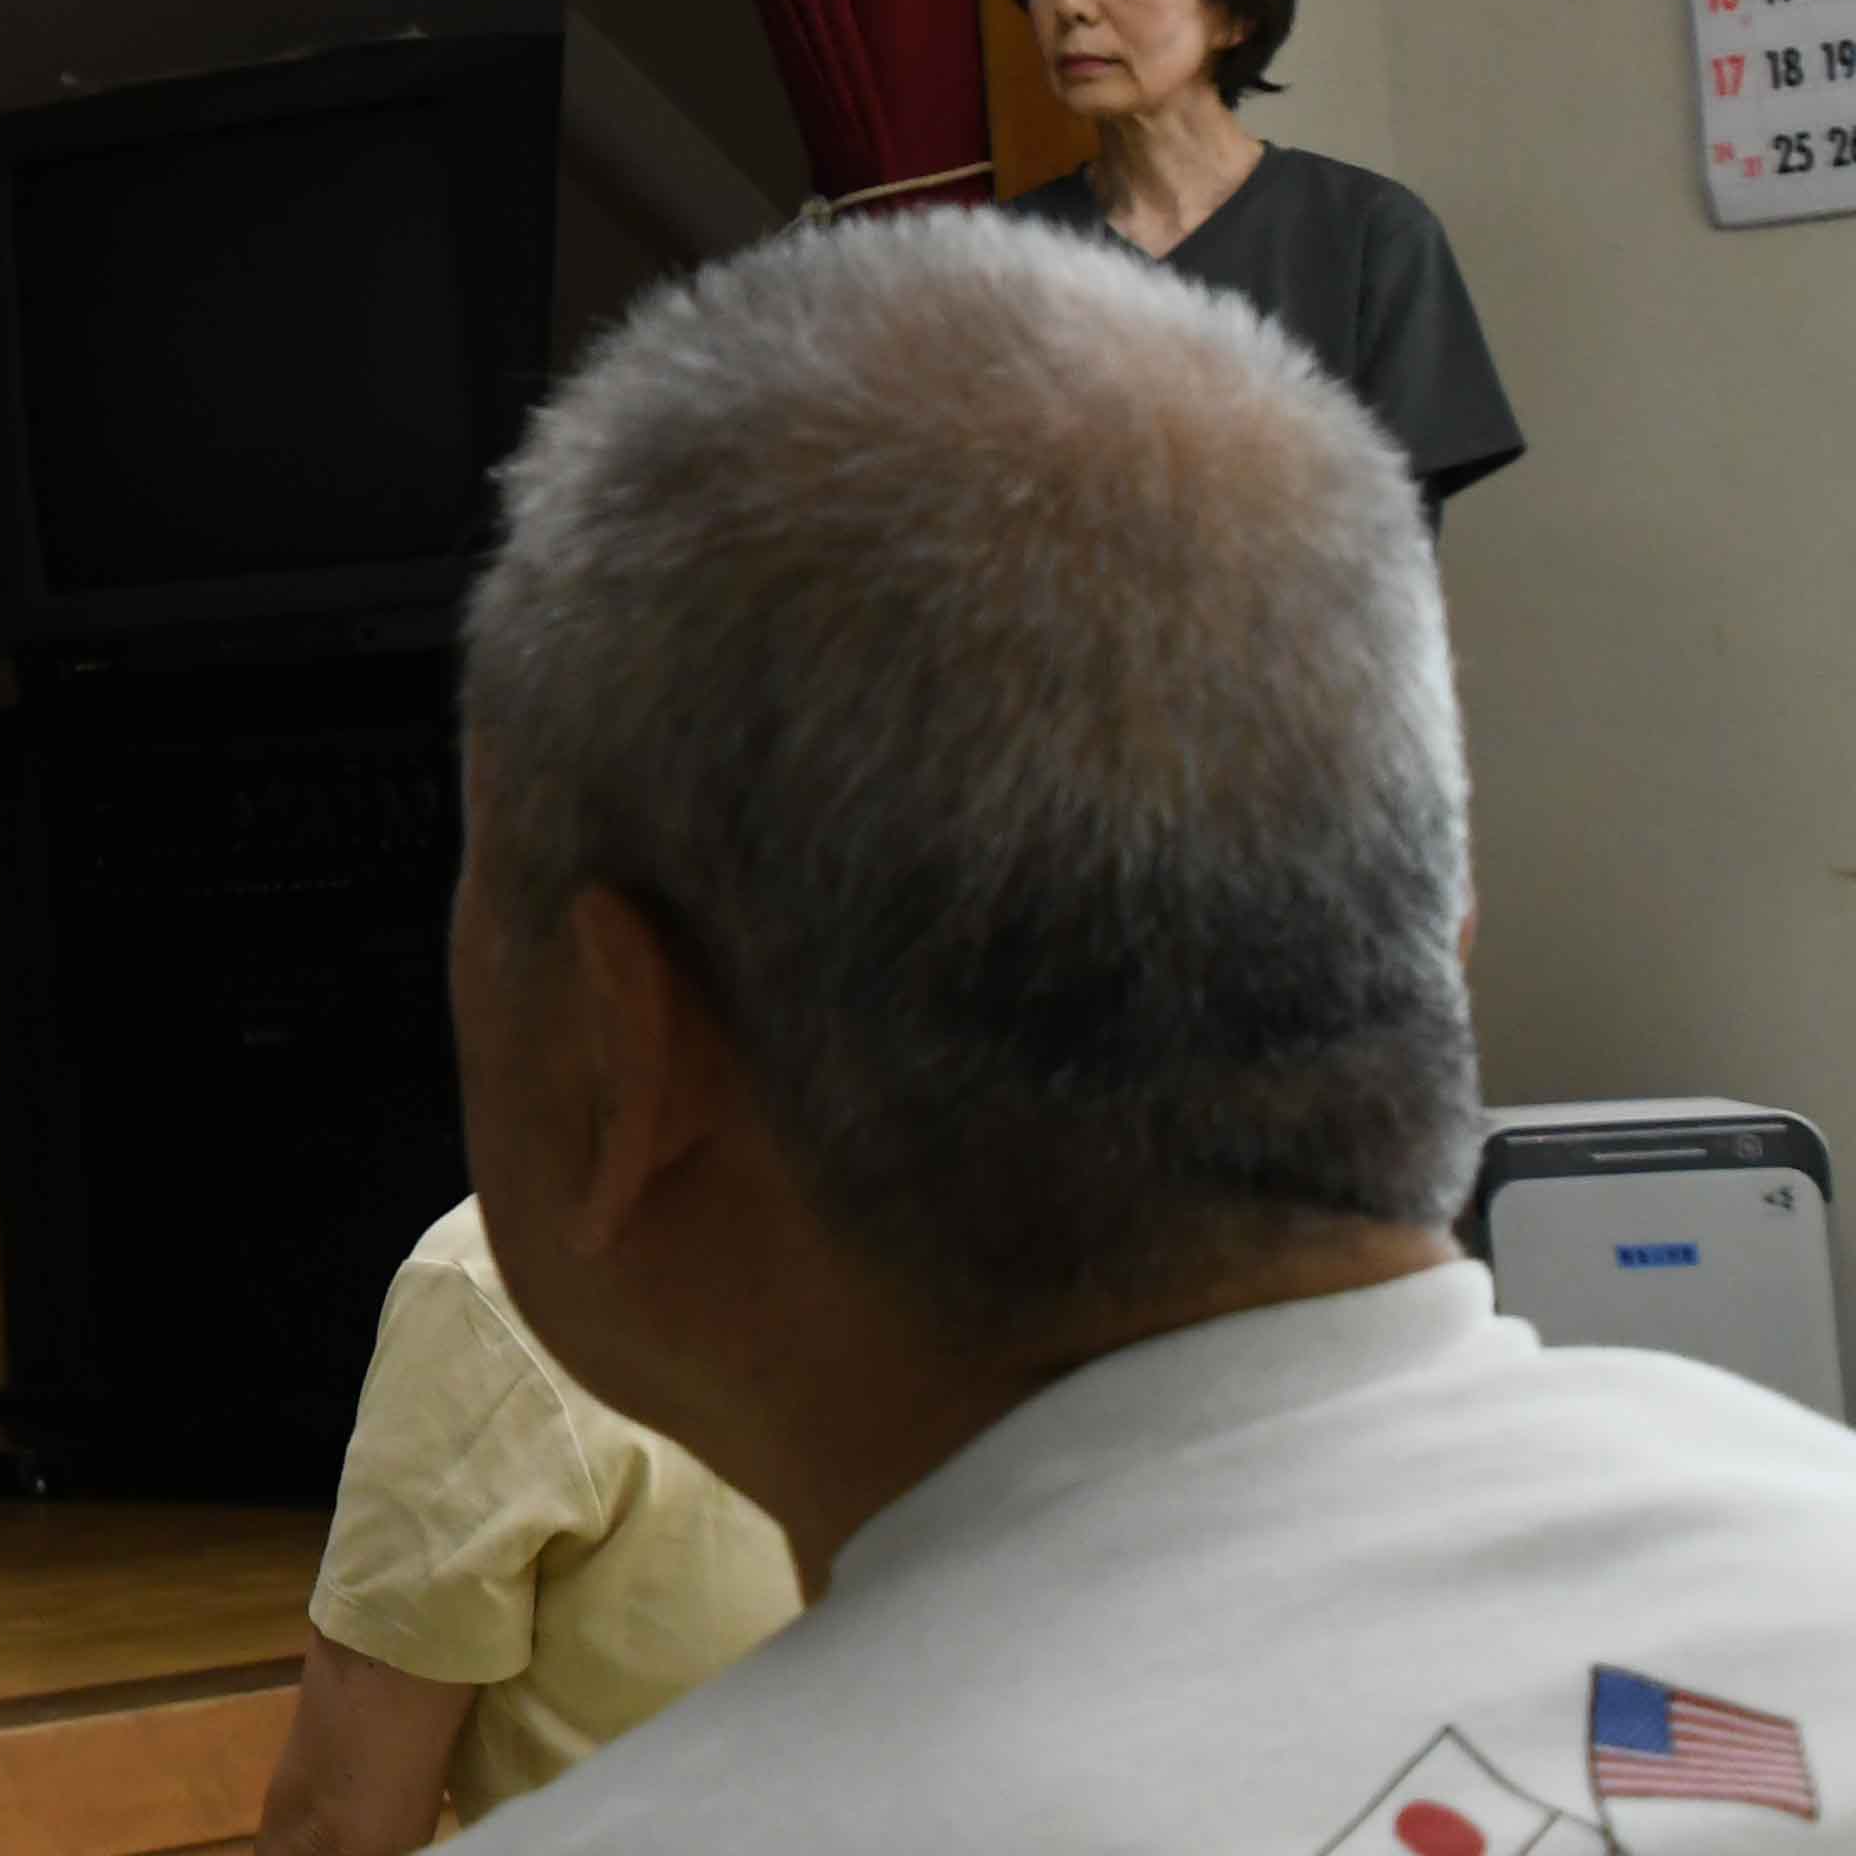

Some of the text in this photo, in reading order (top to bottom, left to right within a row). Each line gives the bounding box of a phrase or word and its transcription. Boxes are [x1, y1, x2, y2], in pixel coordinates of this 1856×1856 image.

[1712, 55, 1746, 96] 17
[1765, 47, 1805, 90] 18
[1772, 131, 1815, 175] 25
